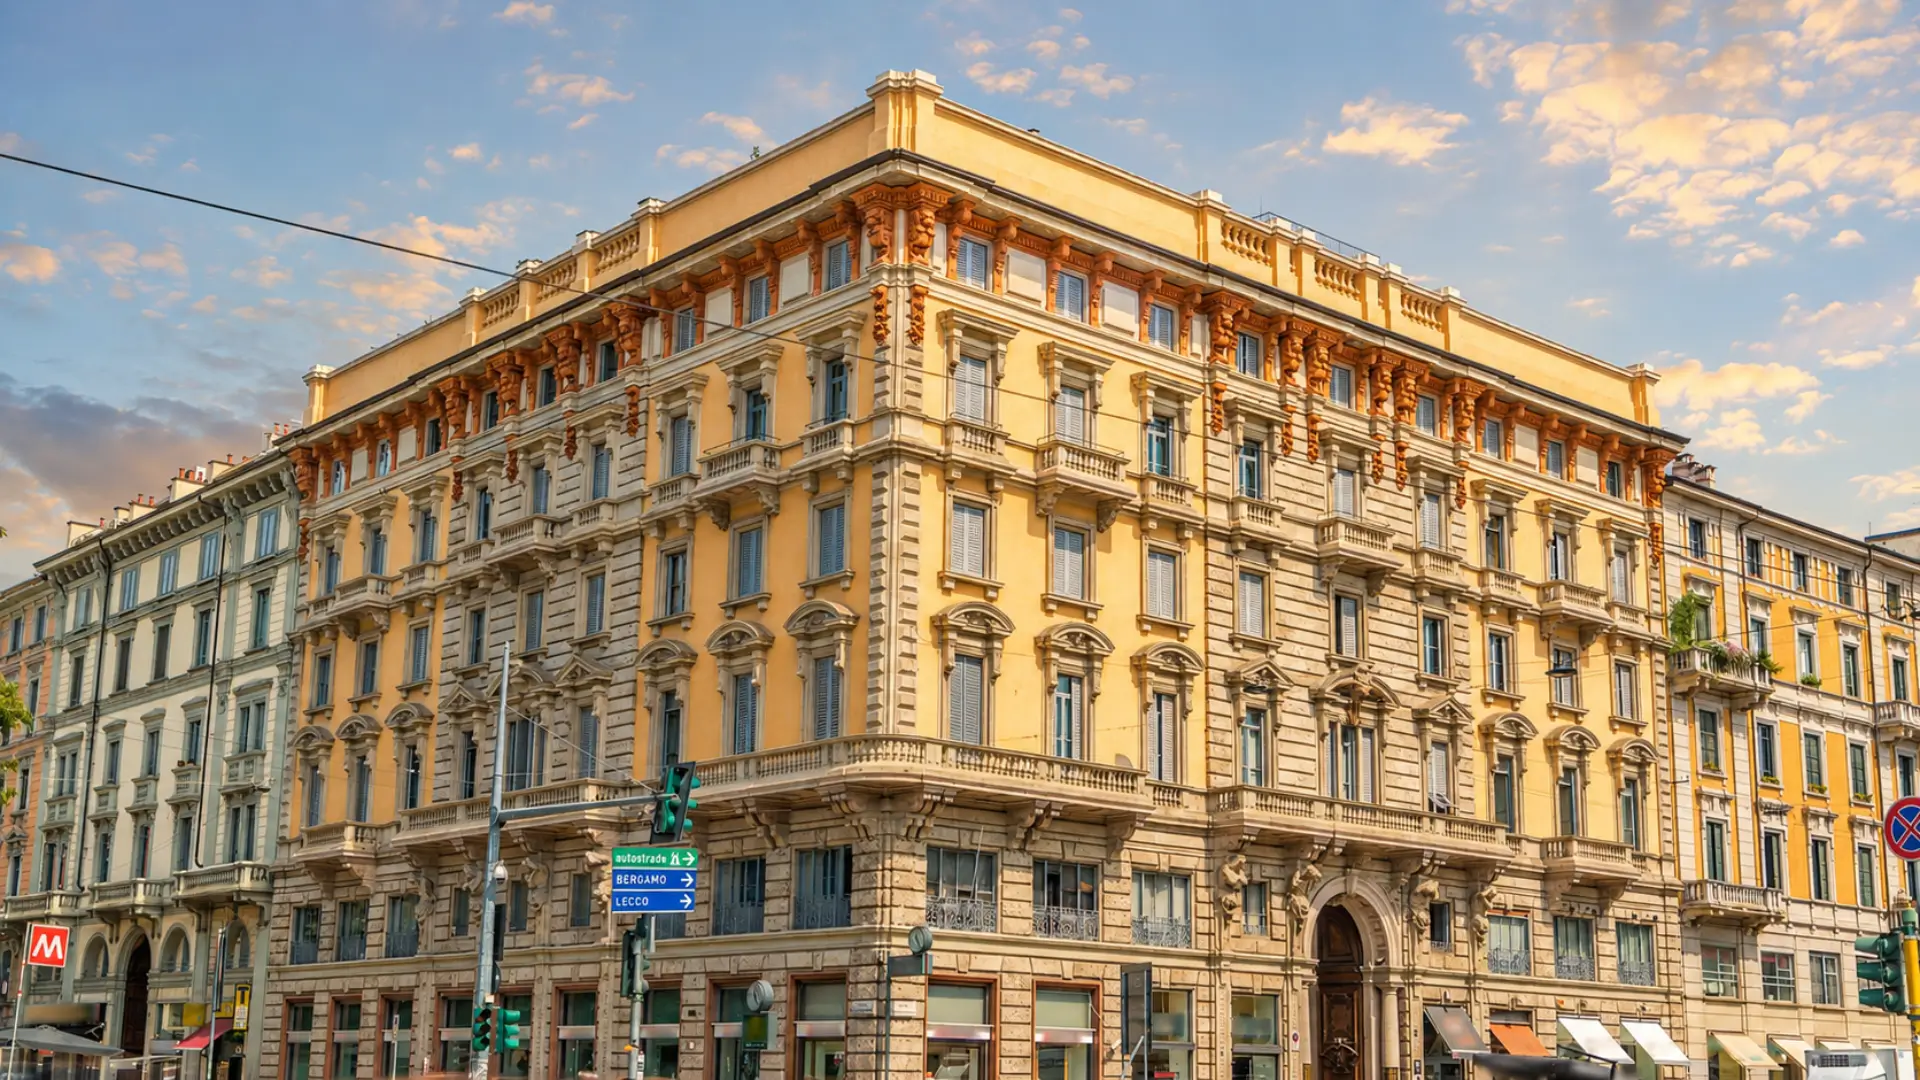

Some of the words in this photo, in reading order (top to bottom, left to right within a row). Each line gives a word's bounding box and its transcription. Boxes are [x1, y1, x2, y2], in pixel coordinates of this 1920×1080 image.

[616, 874, 667, 885] BERGAMO
[615, 896, 649, 907] LECCO
[31, 933, 64, 960] M
